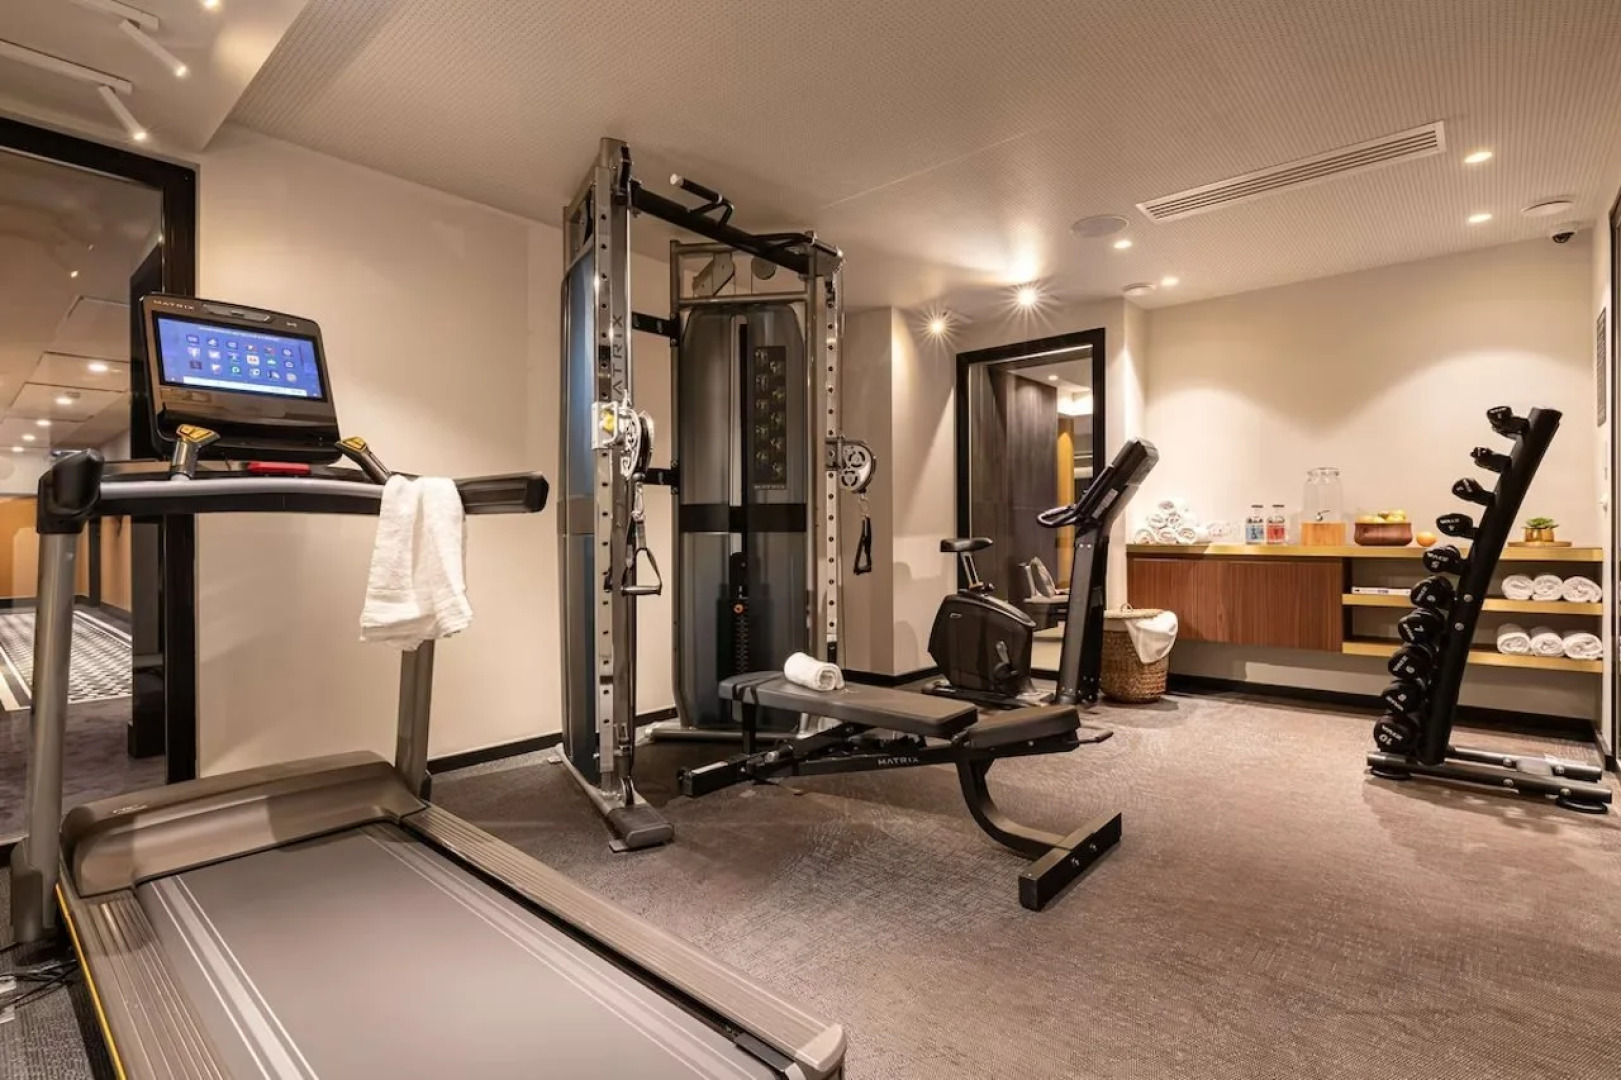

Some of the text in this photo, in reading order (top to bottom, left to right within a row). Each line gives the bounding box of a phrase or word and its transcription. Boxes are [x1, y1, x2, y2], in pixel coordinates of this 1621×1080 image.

[153, 299, 194, 310] MATRIX
[612, 314, 623, 396] ATRIX
[877, 756, 919, 766] MATRIX
